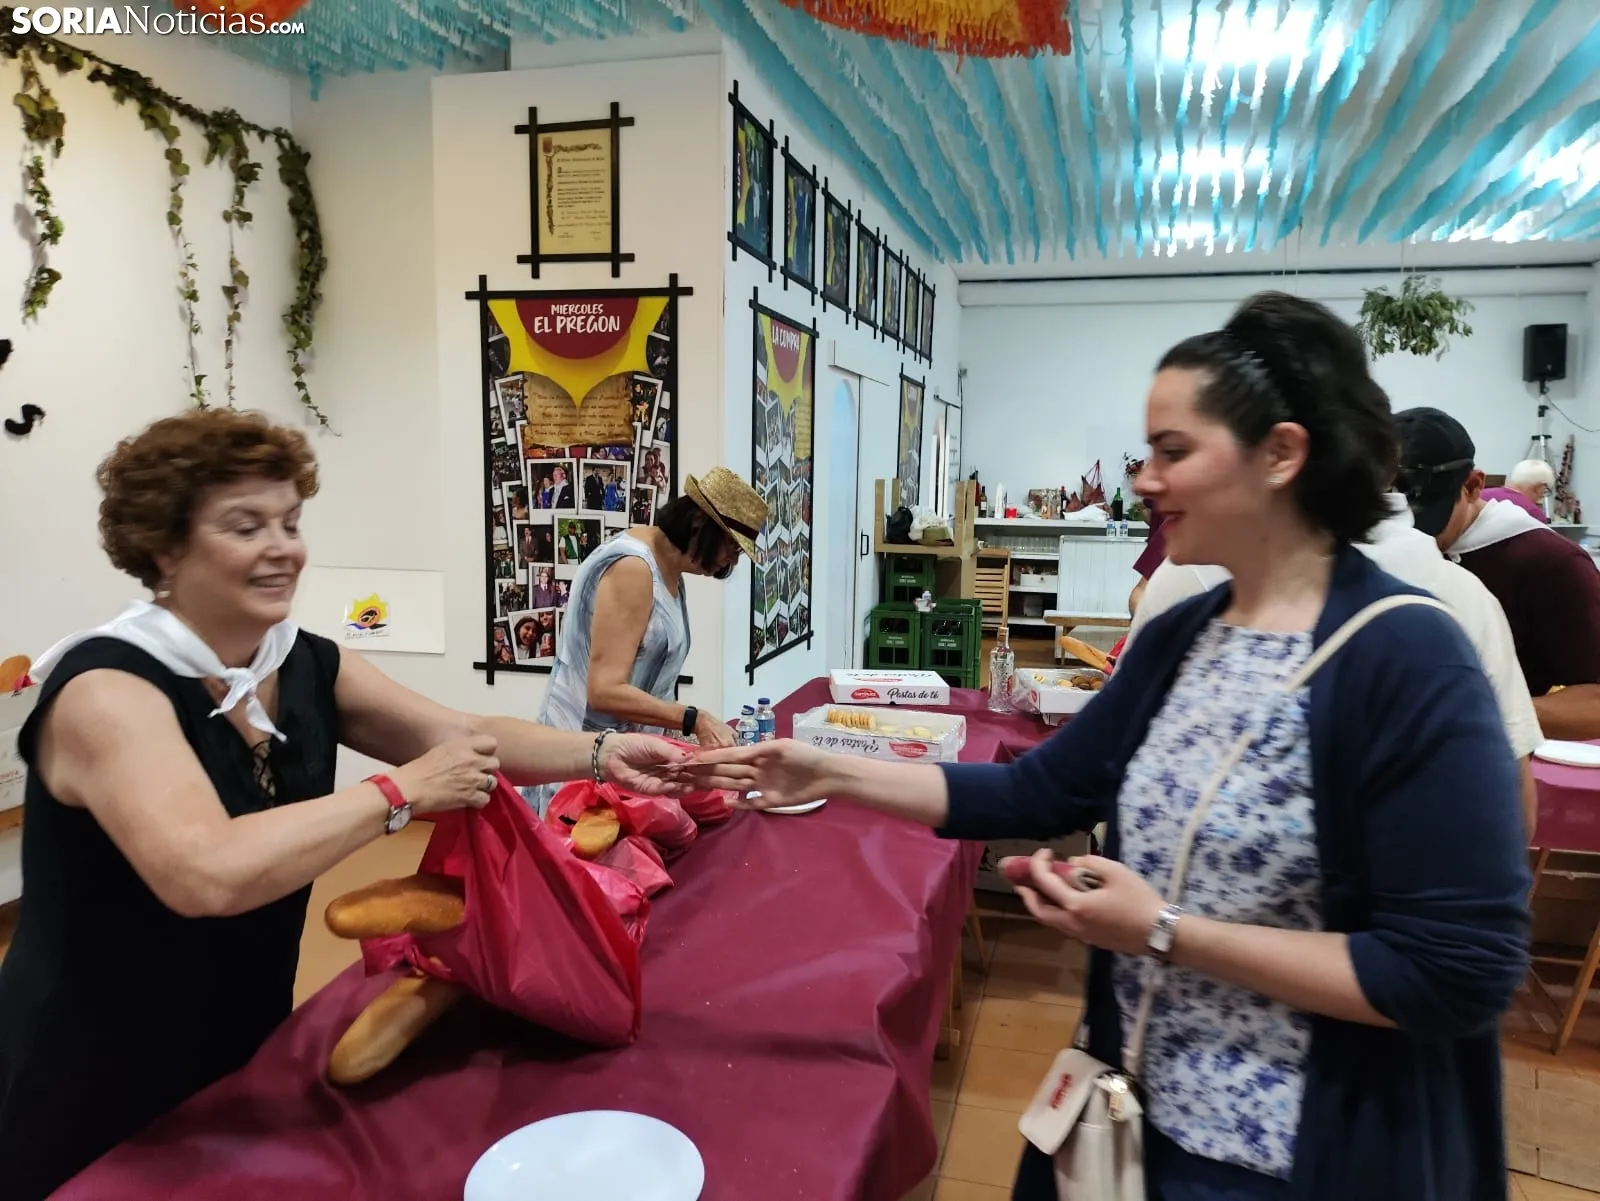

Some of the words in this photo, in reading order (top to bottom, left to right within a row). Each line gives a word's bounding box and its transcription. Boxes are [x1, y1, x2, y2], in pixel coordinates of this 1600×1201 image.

[551, 303, 604, 316] MIERCOLES
[533, 316, 553, 334] EL
[556, 315, 621, 334] PREGON
[772, 325, 779, 346] LA
[887, 688, 916, 700] Pastas
[917, 689, 930, 699] de
[930, 690, 939, 700] té
[824, 735, 839, 747] de
[840, 737, 880, 753] Pastas
